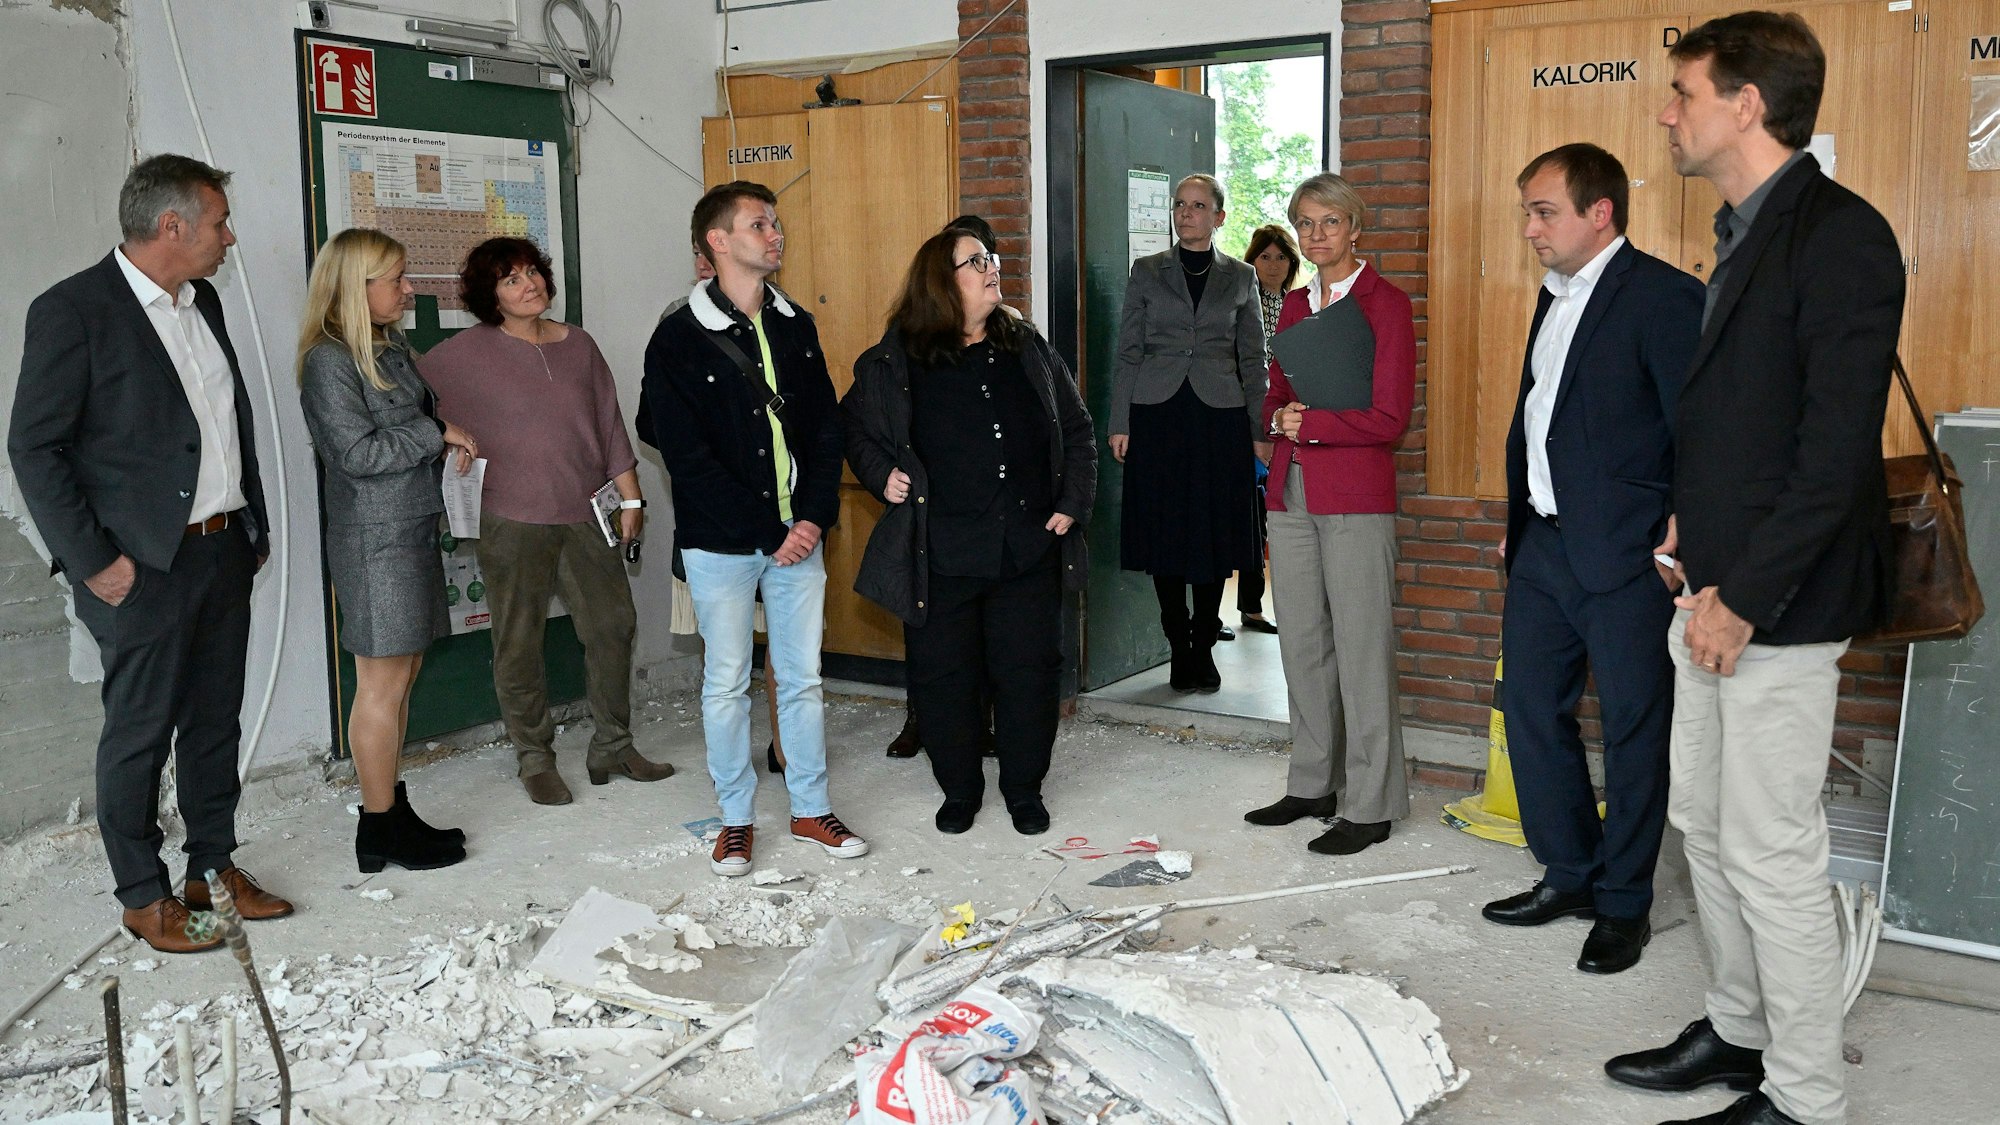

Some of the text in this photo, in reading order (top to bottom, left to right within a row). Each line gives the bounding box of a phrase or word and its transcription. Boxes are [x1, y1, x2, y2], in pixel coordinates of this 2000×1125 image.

[1971, 36, 2000, 60] M
[1533, 60, 1637, 88] KALORIK
[337, 130, 446, 147] Periodensystem der Elemente
[728, 144, 793, 165] ELEKTRIK
